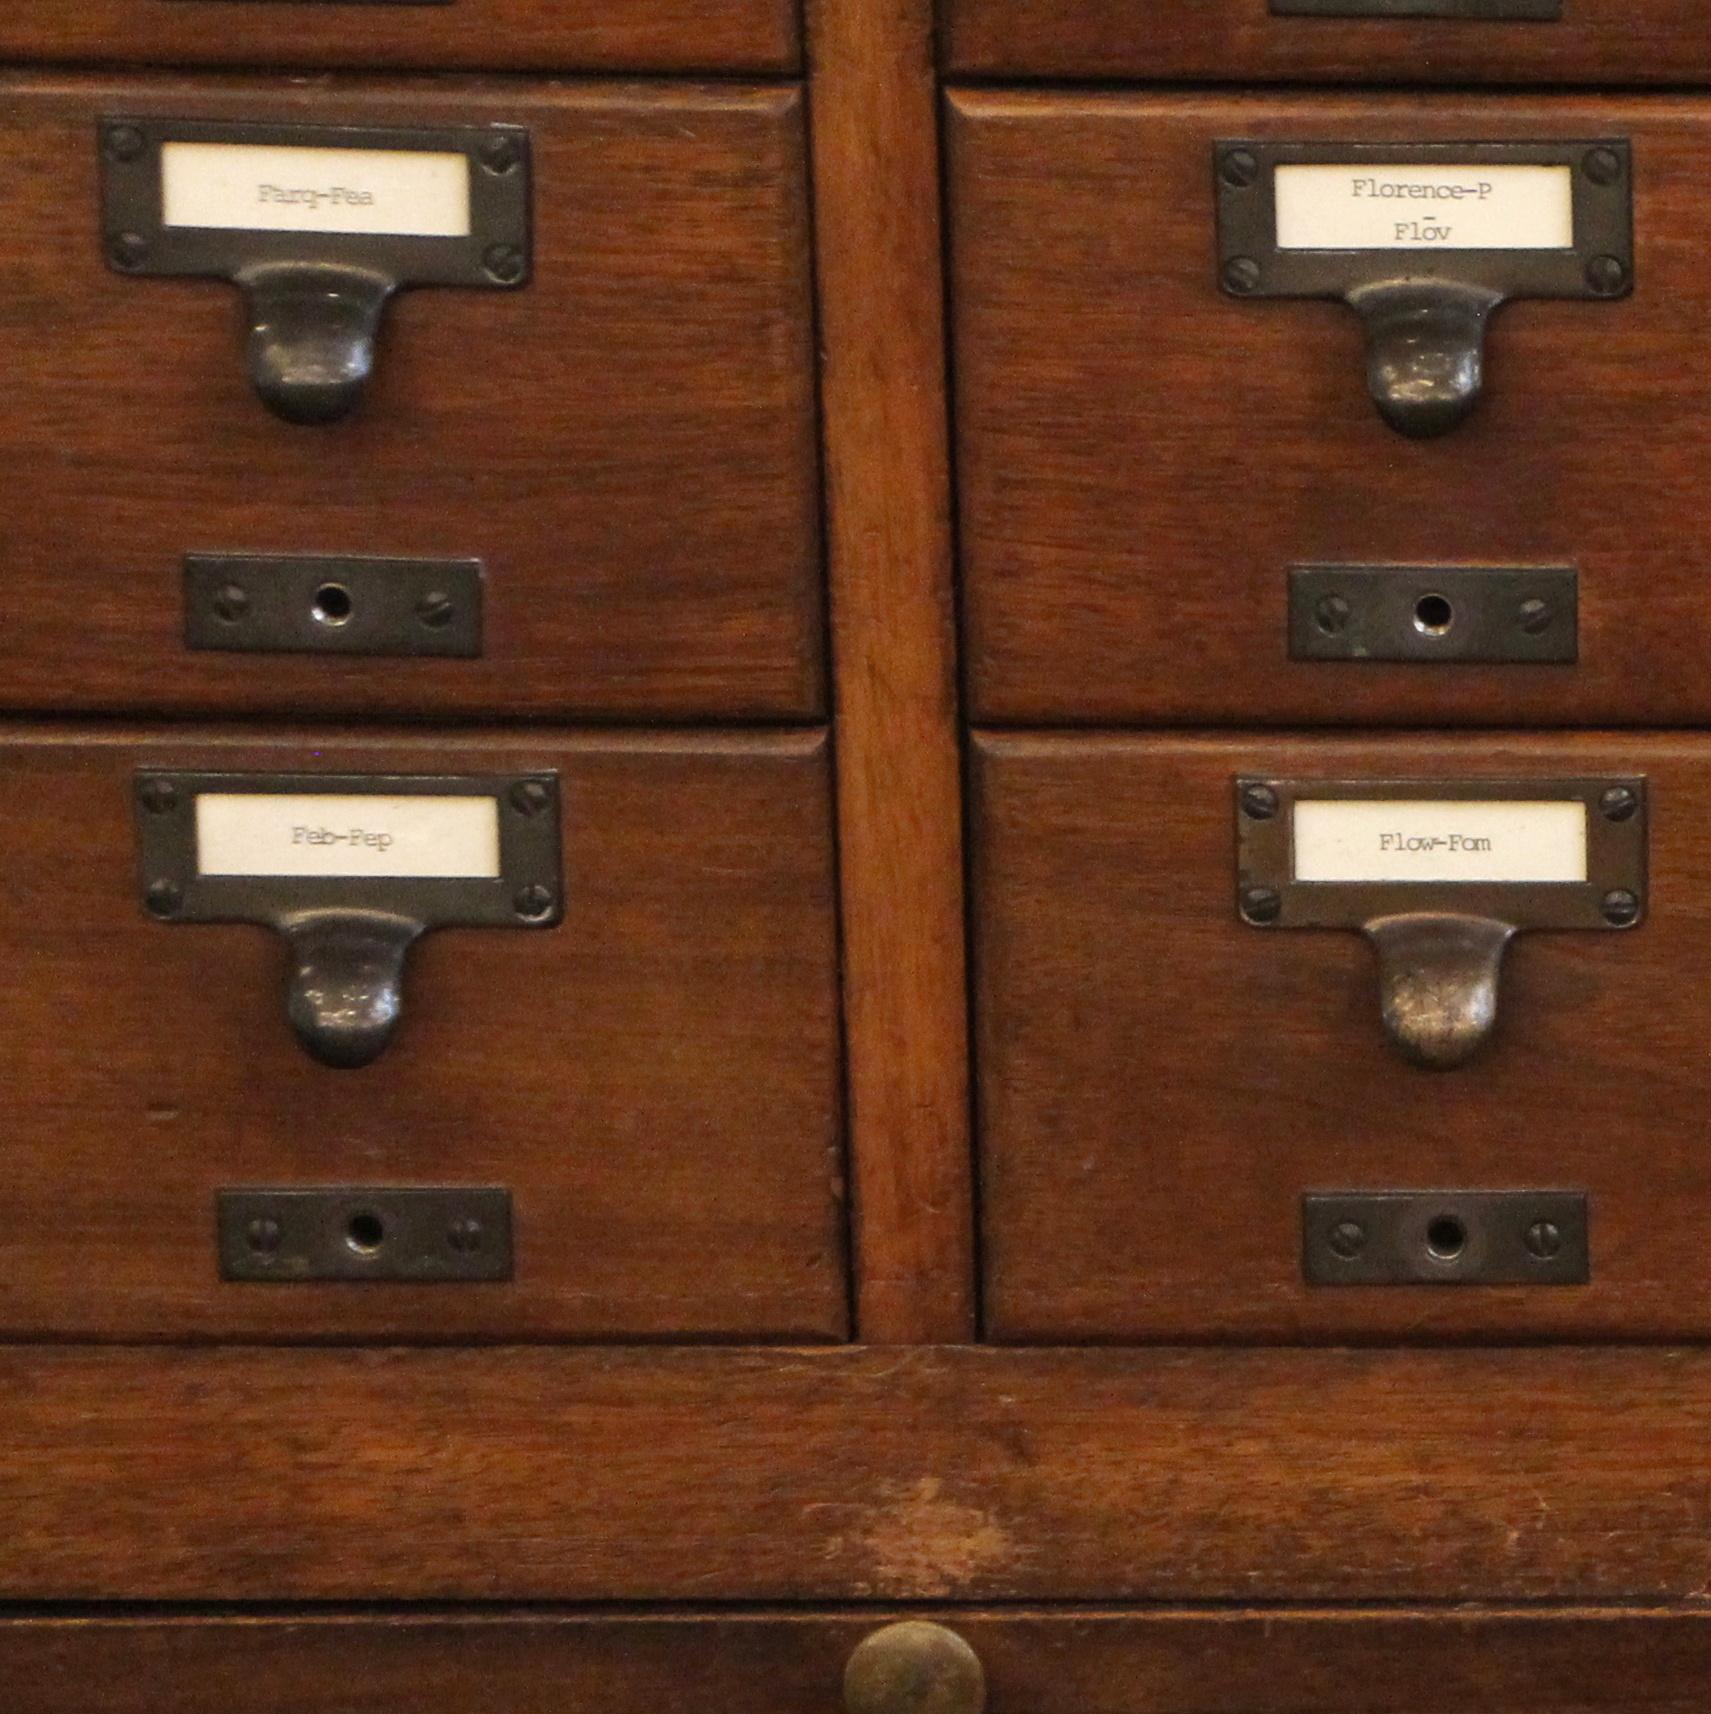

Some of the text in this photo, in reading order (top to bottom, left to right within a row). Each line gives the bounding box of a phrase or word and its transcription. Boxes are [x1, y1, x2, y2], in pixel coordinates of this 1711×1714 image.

[1351, 179, 1493, 202] Florence-P
[291, 826, 394, 853] Feb-Fep
[1378, 832, 1492, 853] Flow-Fom
